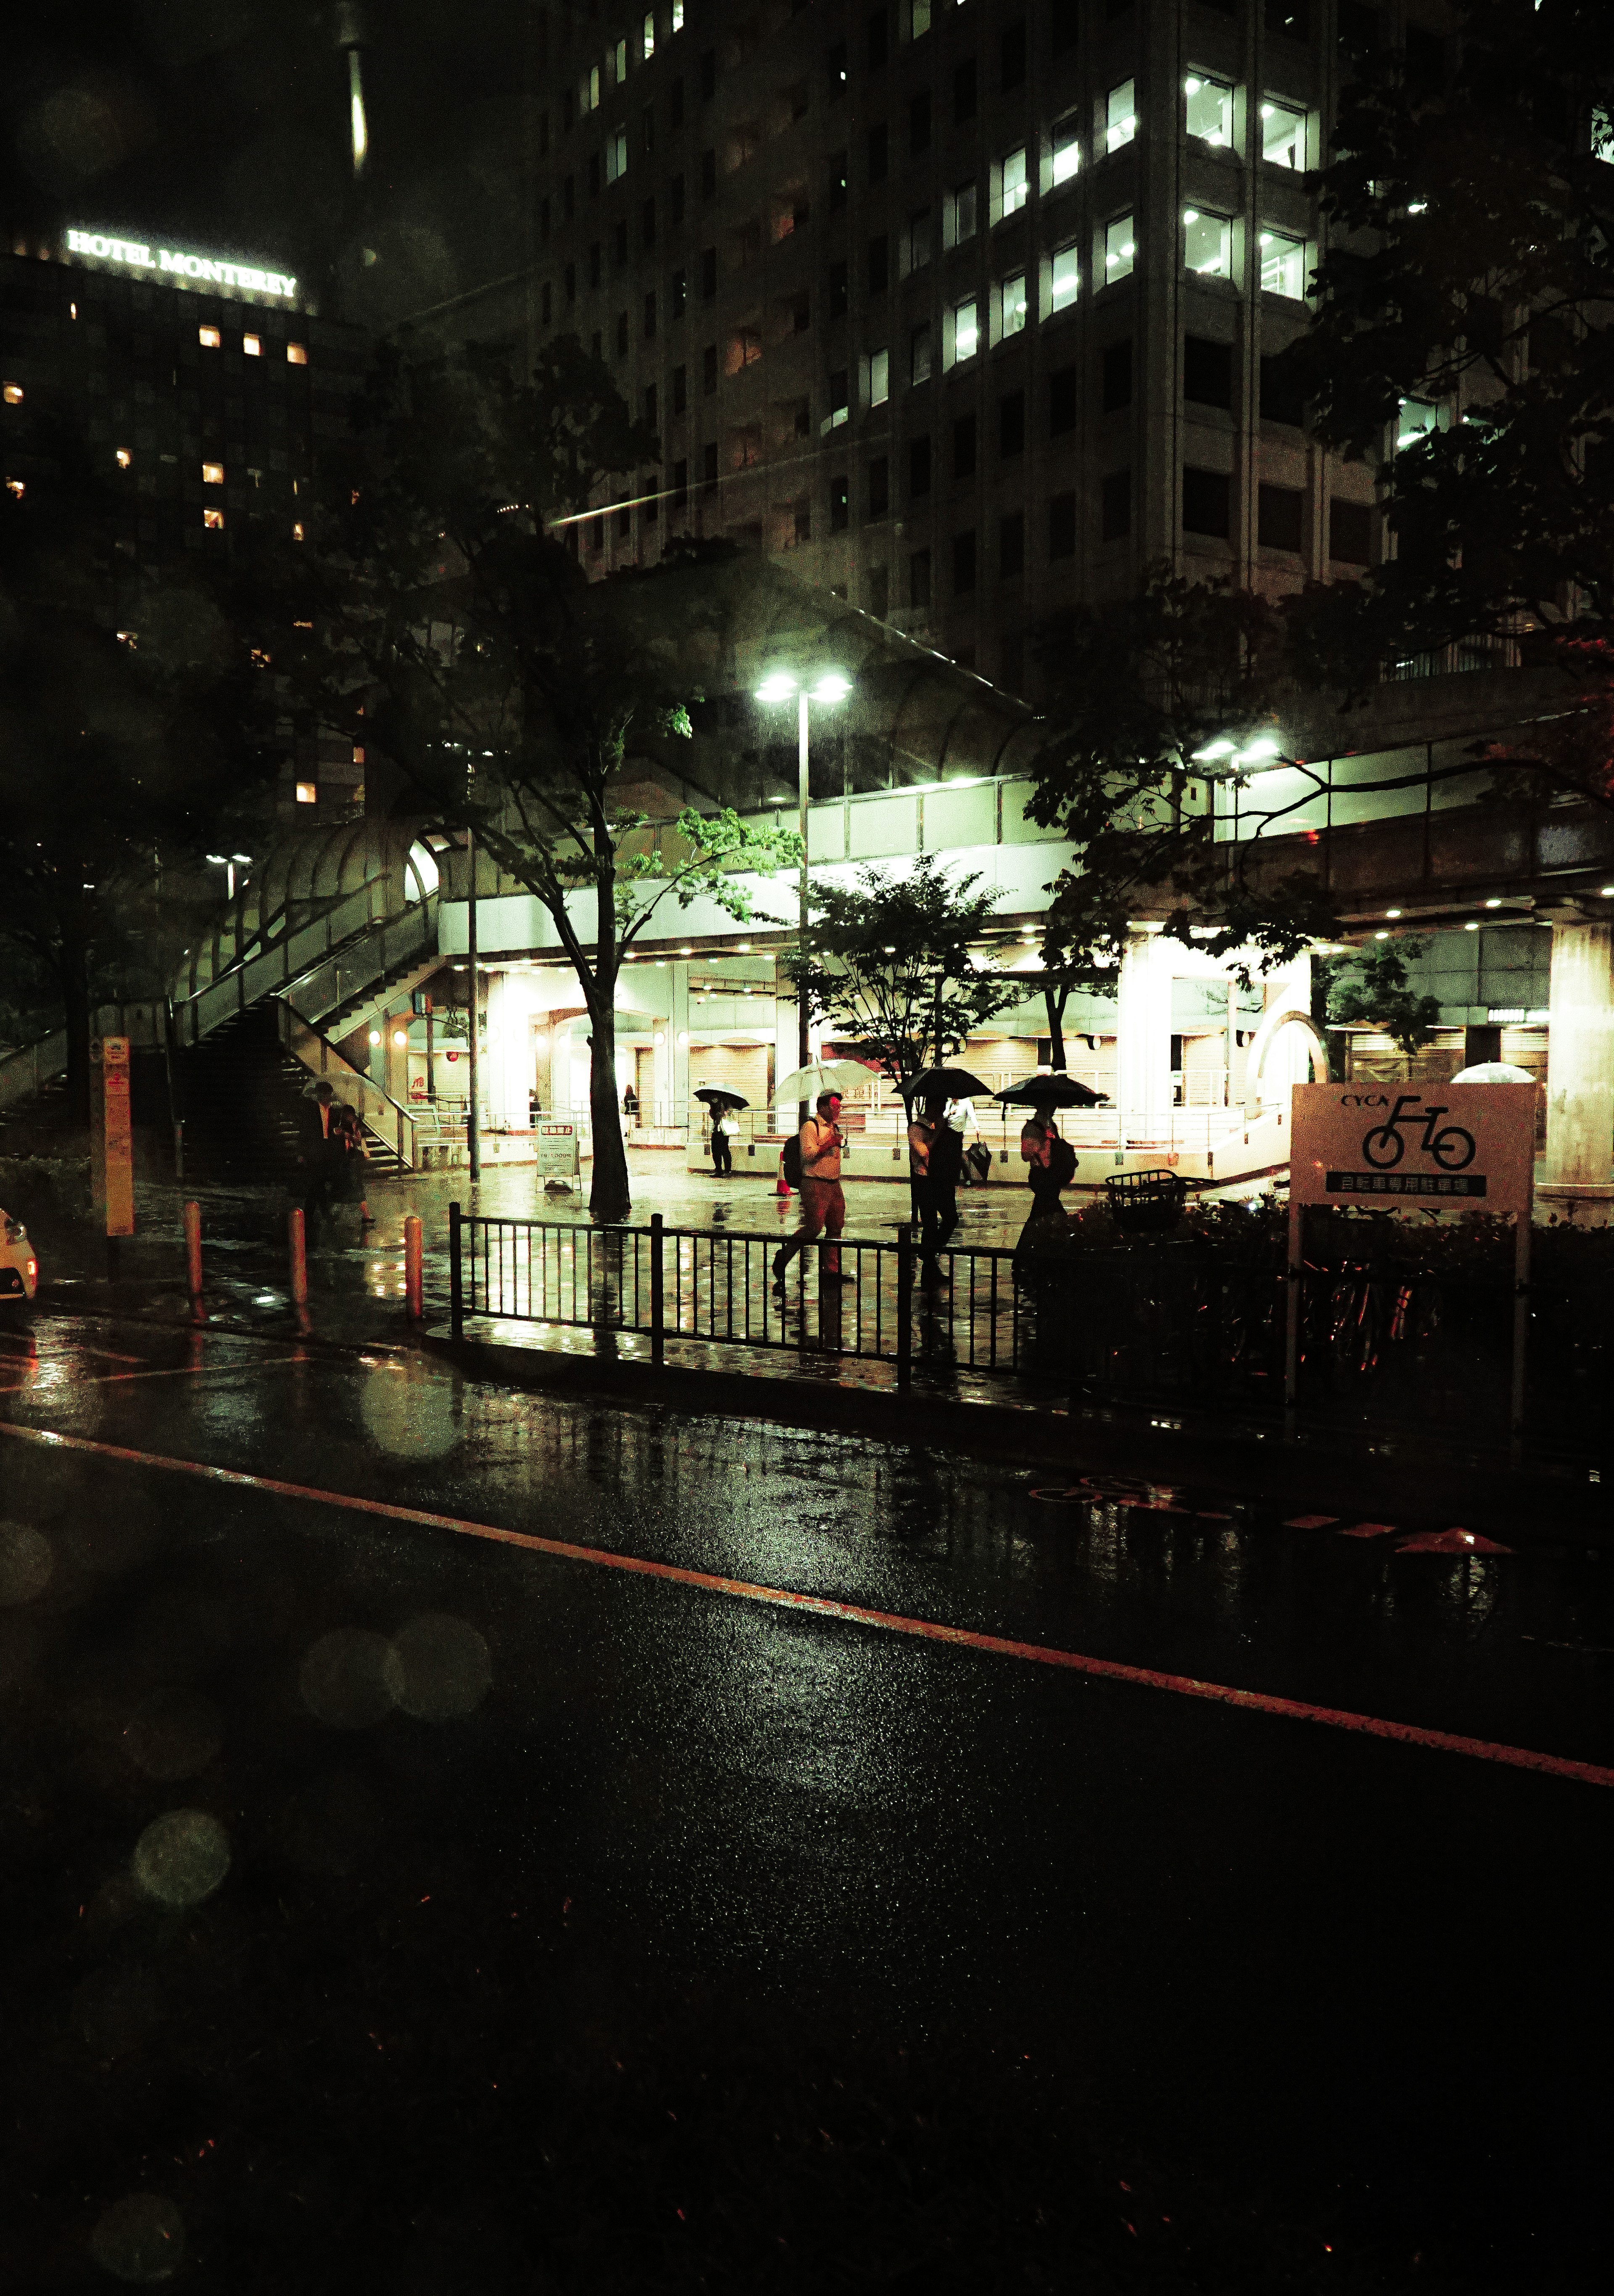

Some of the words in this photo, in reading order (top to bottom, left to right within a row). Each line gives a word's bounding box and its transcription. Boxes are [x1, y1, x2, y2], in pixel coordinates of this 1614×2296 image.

[68, 230, 155, 267] HOTEL
[160, 250, 296, 297] MONTEREY
[1341, 1095, 1388, 1106] CYCA
